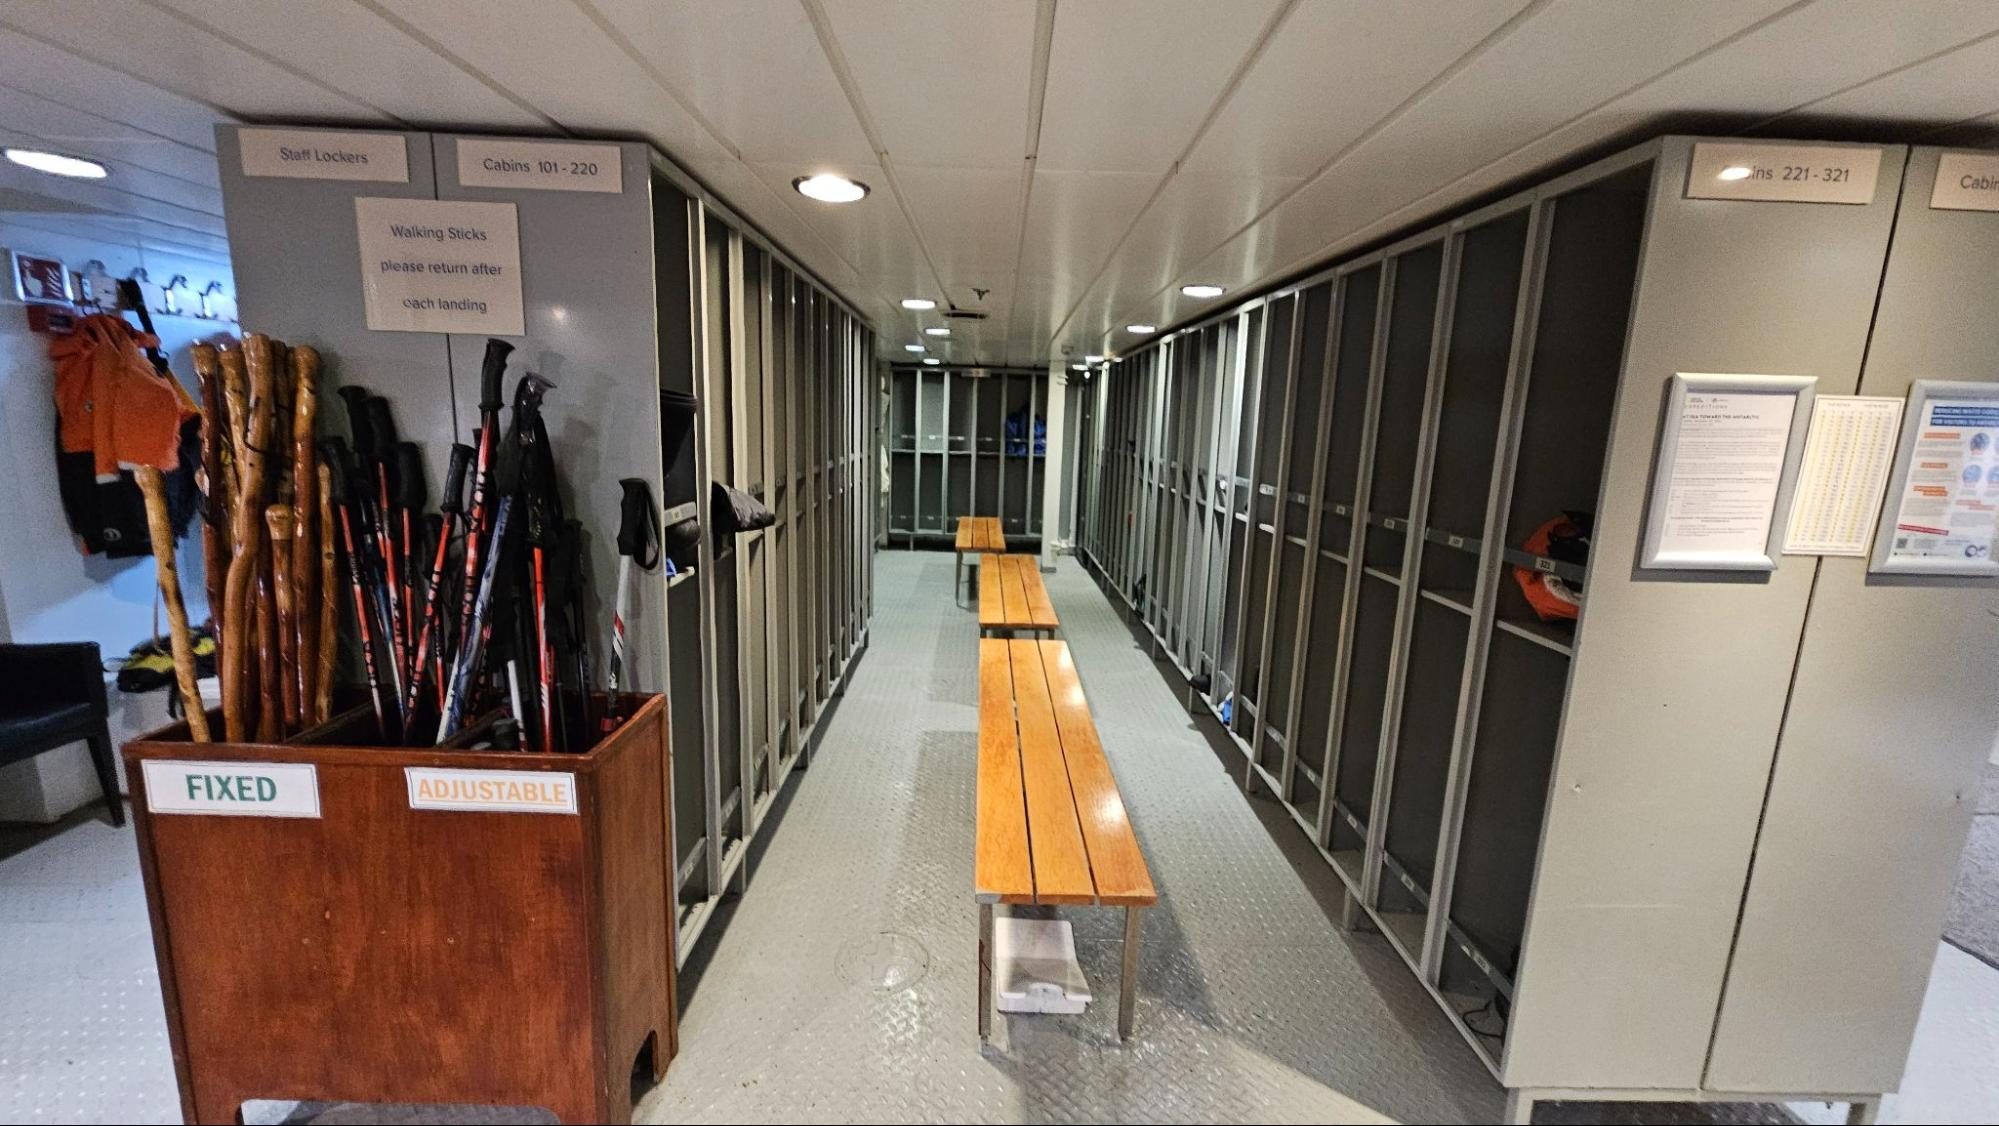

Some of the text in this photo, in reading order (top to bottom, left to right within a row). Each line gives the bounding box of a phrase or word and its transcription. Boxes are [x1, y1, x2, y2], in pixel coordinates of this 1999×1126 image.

[279, 146, 369, 164] Staff Lockers
[483, 158, 531, 173] Cabins
[538, 160, 559, 174] 101
[571, 162, 598, 175] 220
[1782, 166, 1810, 182] 221
[1822, 168, 1850, 183] 321
[390, 225, 488, 242] Walking Sticks
[380, 259, 502, 276] please return after
[402, 297, 487, 315] each landing
[185, 774, 278, 802] FIXED
[418, 778, 567, 803] ADJUSTABLE
